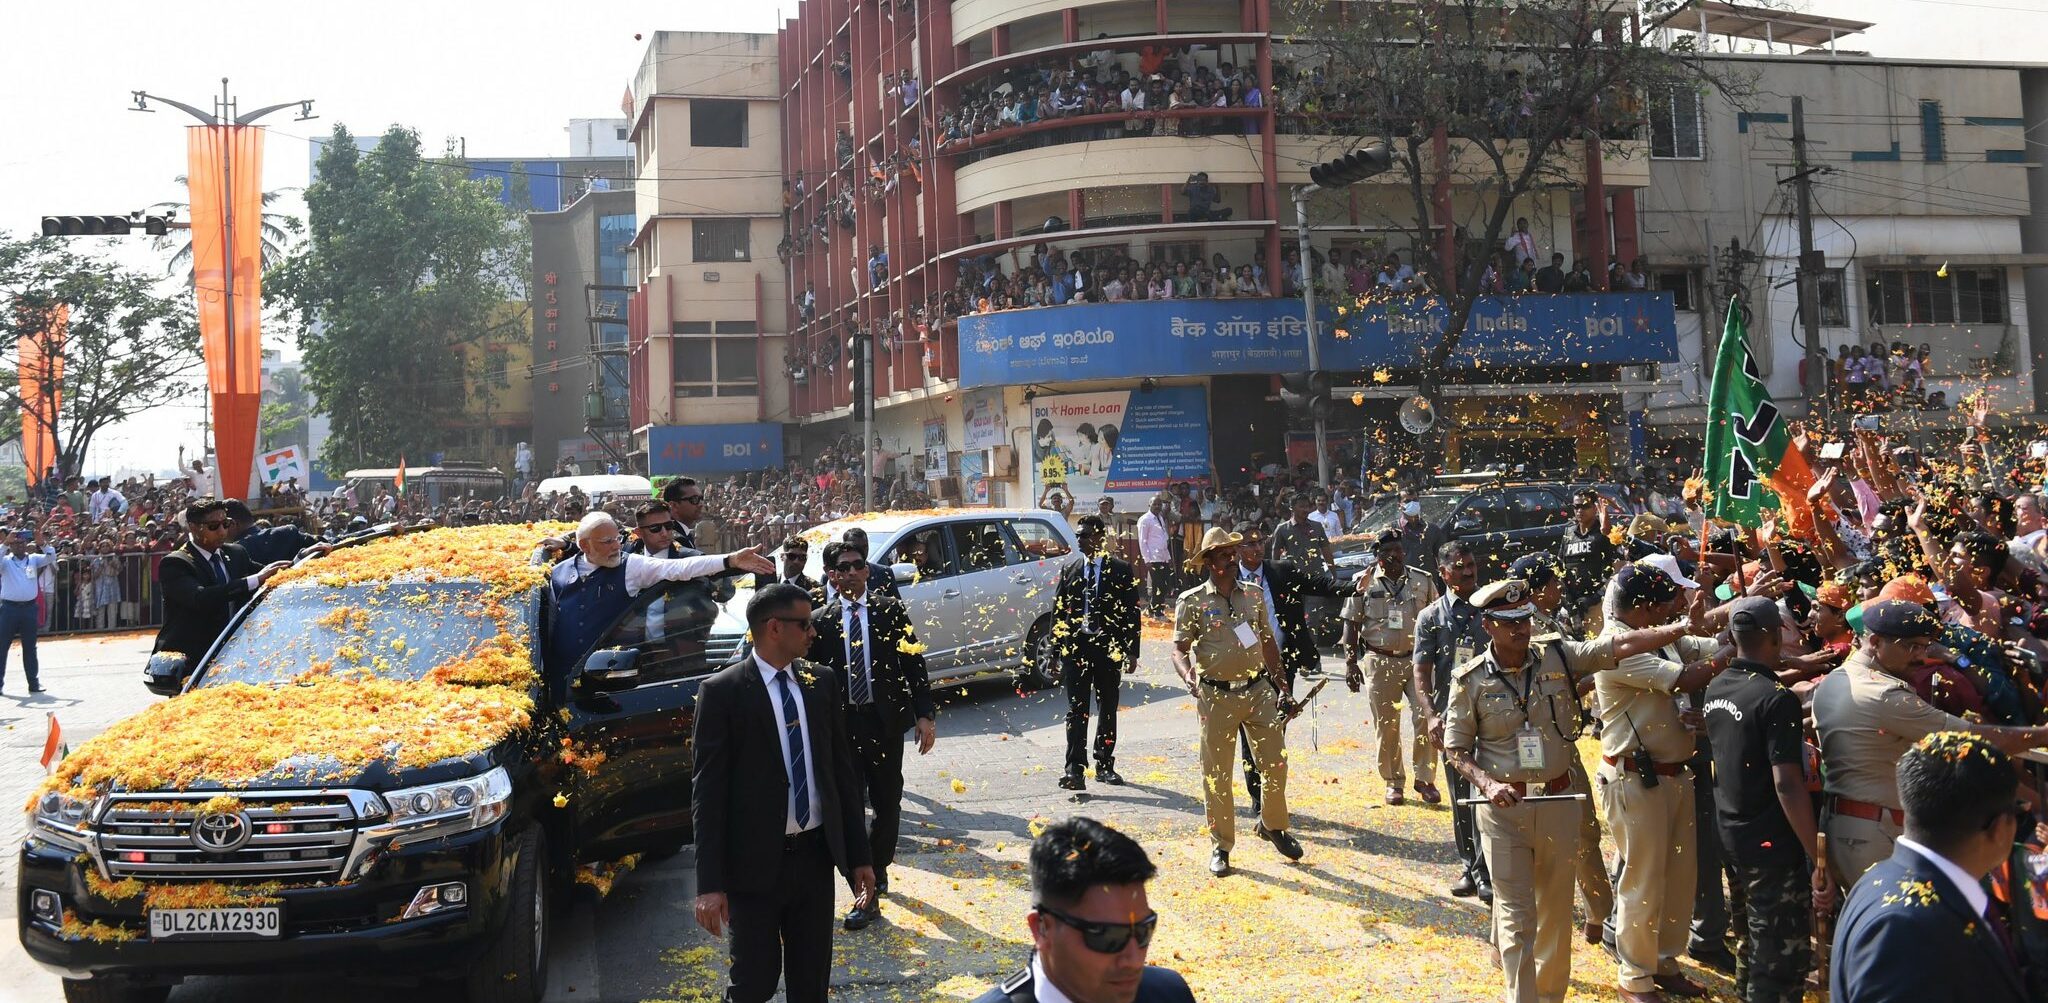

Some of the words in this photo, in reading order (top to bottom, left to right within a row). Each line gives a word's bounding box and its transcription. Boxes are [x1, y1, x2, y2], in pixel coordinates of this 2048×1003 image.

[1170, 316, 1207, 338] बैंक
[1387, 313, 1443, 334] Bank
[1475, 311, 1528, 332] India
[1585, 317, 1624, 337] BOI
[1035, 407, 1049, 418] BOI
[1060, 404, 1090, 416] Home
[1092, 403, 1121, 414] Loan
[660, 442, 705, 463] ATM
[723, 444, 751, 457] BOI
[1566, 541, 1592, 555] POLICE
[162, 911, 277, 932] DL2CAX2930
